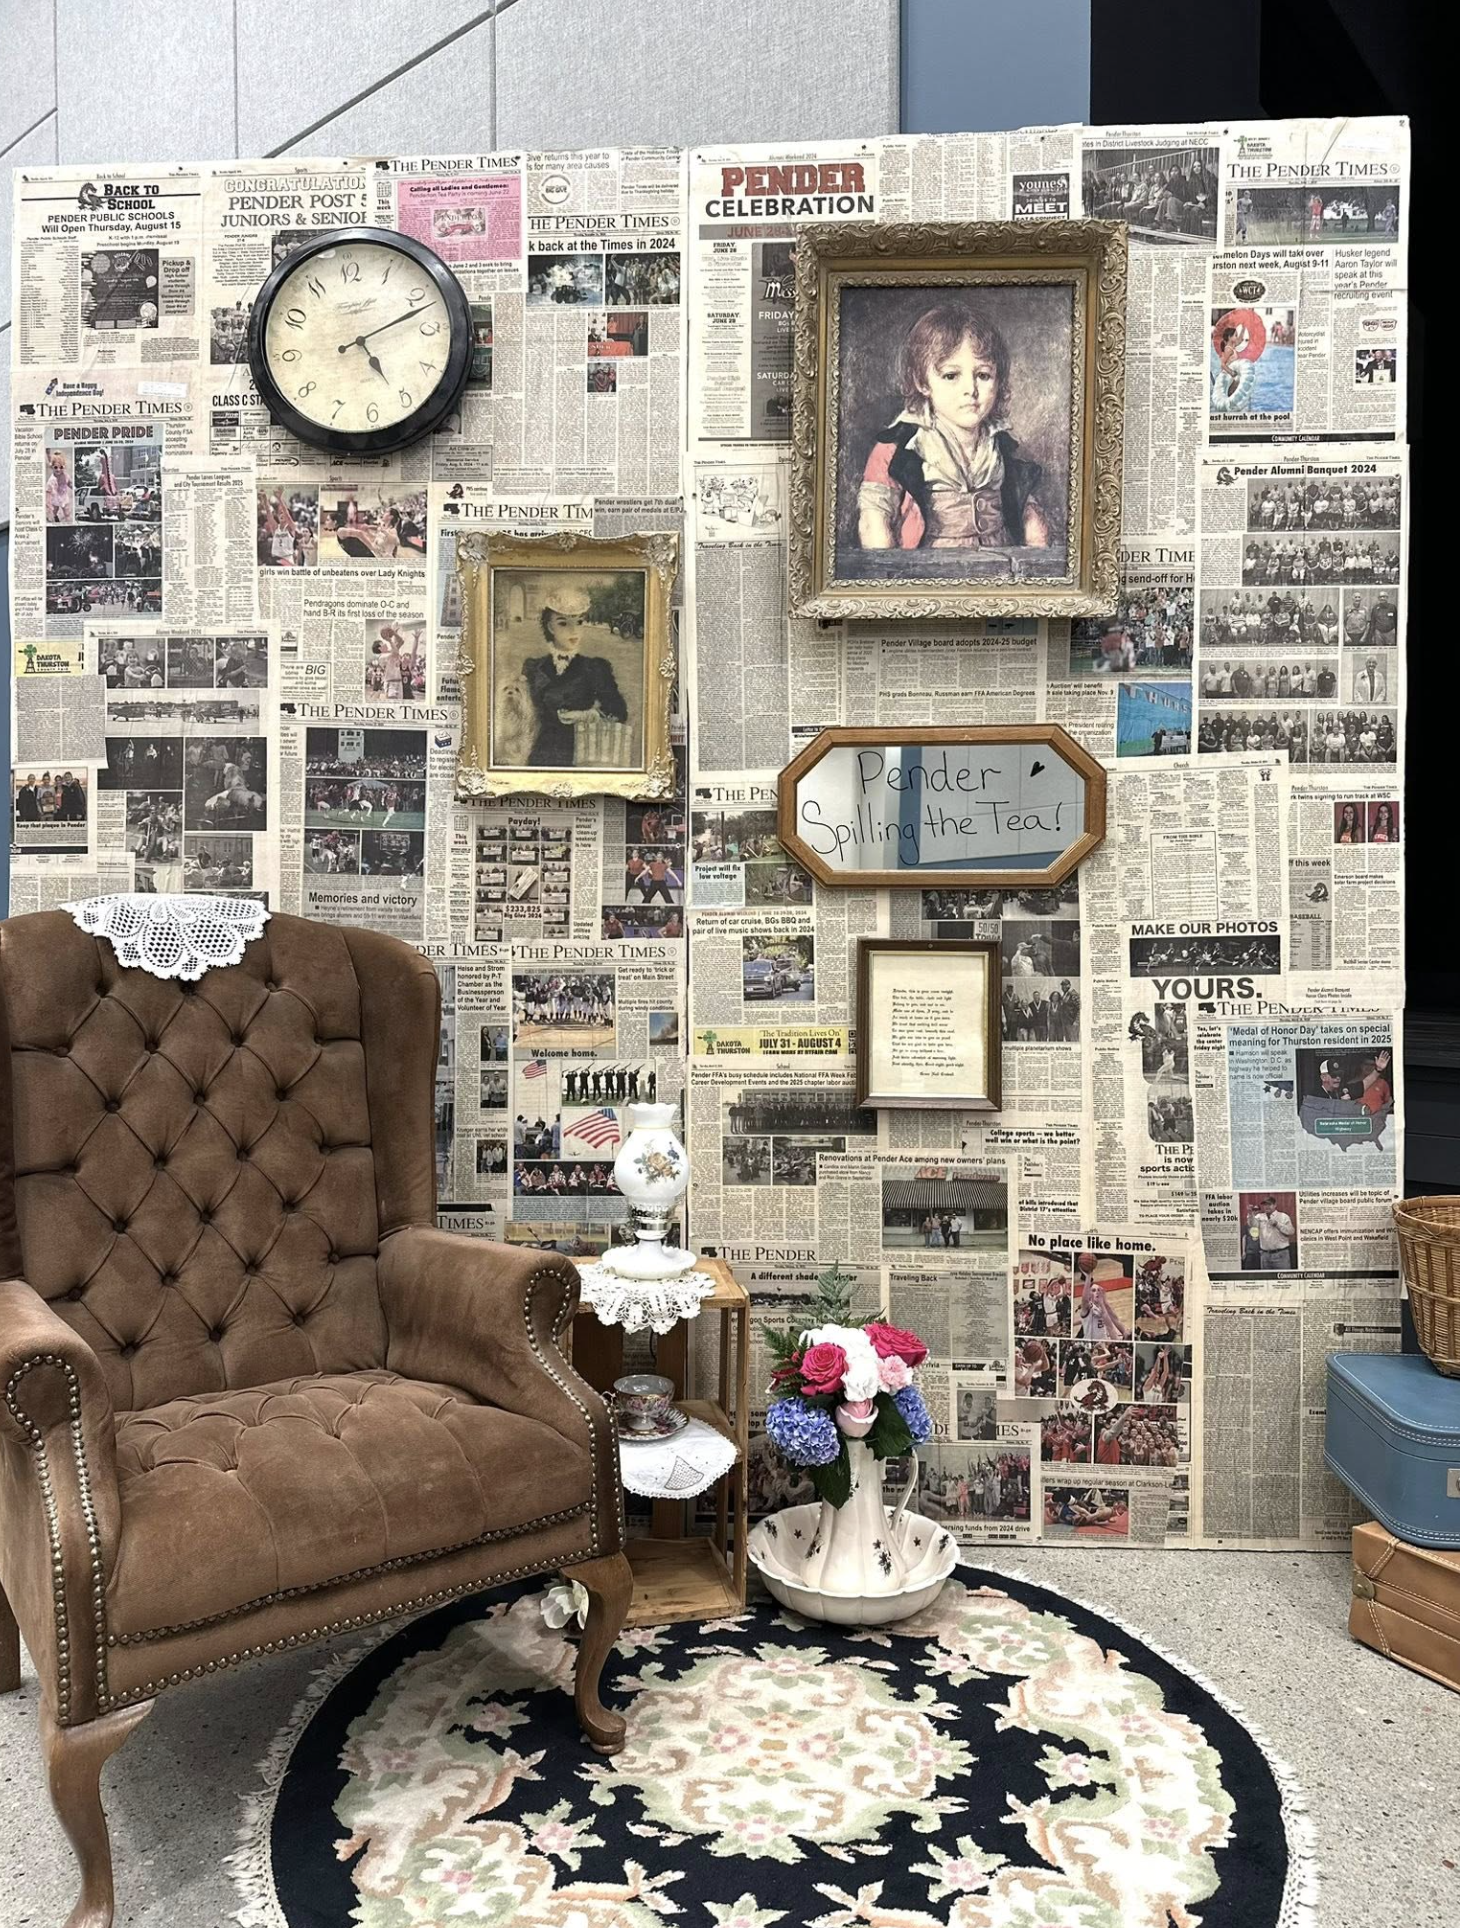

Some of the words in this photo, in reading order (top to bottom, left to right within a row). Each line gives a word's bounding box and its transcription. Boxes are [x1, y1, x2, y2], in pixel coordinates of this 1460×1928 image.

[390, 159, 418, 172] THE
[421, 157, 473, 172] PENDER
[476, 156, 518, 170] TIMES
[1226, 163, 1261, 178] THE
[1266, 161, 1330, 177] PENDER
[1335, 161, 1388, 176] TIMES
[720, 161, 866, 197] PENDER
[104, 184, 140, 197] BACK
[143, 184, 159, 196] TO
[107, 198, 156, 210] SCHOOL
[228, 194, 304, 211] PENDER
[309, 192, 356, 208] POST
[705, 194, 874, 218] CELEBRATION
[47, 213, 87, 223] PENDER
[89, 212, 125, 222] PUBLIC
[127, 210, 174, 221] SCHOOLS
[220, 212, 290, 227] JUNIORS
[295, 212, 306, 225] &
[556, 216, 616, 230] PENDER
[620, 214, 669, 228] TIMES
[41, 224, 58, 233] Will
[60, 223, 85, 234] Open
[87, 222, 132, 233] Thursday,
[134, 221, 167, 232] August
[170, 220, 181, 229] 15
[538, 239, 564, 252] back
[566, 240, 577, 251] at
[580, 239, 598, 251] the
[600, 238, 633, 250] Times
[636, 238, 646, 249] in
[649, 237, 675, 249] 2024
[1213, 250, 1248, 259] melon
[1250, 249, 1270, 259] Days
[1272, 249, 1287, 258] will
[340, 262, 362, 284] 12
[381, 266, 392, 285] 1
[307, 277, 326, 299] 11
[406, 287, 426, 307] 2
[284, 308, 307, 330] 10
[420, 320, 440, 336] 3
[282, 349, 302, 362] 9
[418, 360, 436, 376] 4
[298, 381, 316, 398] 8
[212, 394, 240, 407] CLASS
[241, 394, 248, 406] C
[398, 387, 412, 408] 5
[36, 402, 68, 416] THE
[71, 401, 131, 416] PENDER
[134, 399, 182, 414] TIMES
[331, 399, 346, 419] 7
[366, 402, 379, 423] 6
[1222, 412, 1248, 421] hurrah
[1273, 412, 1290, 421] pool
[53, 426, 109, 440] PENDER
[111, 425, 153, 439] PRIDE
[1234, 465, 1268, 475] Pender
[1270, 464, 1304, 475] Alumni
[1306, 464, 1347, 476] Banquet
[1350, 463, 1376, 473] 2024
[461, 503, 494, 518] THE
[498, 504, 558, 518] PENDER
[259, 567, 275, 577] girls
[290, 568, 311, 576] battle
[312, 567, 320, 576] of
[321, 568, 359, 576] unbeatens
[377, 568, 396, 579] Lady
[397, 568, 425, 579] Knights
[303, 598, 345, 610] Pendragons
[346, 599, 378, 608] dominate
[379, 599, 395, 608] O-C
[395, 600, 409, 609] and
[880, 638, 907, 647] Pender
[907, 638, 932, 648] Village
[933, 638, 954, 646] board
[955, 637, 980, 647] adopts
[981, 636, 1010, 646] 2024-25
[1011, 636, 1037, 647] budget
[298, 702, 330, 718] THE
[334, 704, 395, 719] PENDER
[400, 706, 448, 720] TIMES
[857, 750, 1002, 794] Pender
[713, 787, 746, 801] THE
[508, 816, 540, 827] Payday!
[802, 800, 920, 866] Spilling
[924, 804, 978, 838] the
[975, 801, 1062, 834] Tea!
[308, 891, 358, 907] Memories
[360, 893, 379, 904] and
[382, 893, 417, 907] victory
[504, 905, 541, 914] $233,825
[1131, 923, 1175, 936] MAKE
[1179, 922, 1211, 935] OUR
[1216, 920, 1278, 934] PHOTOS
[450, 944, 498, 956] TIMES
[514, 945, 548, 958] THE
[553, 944, 614, 958] PENDER
[617, 944, 666, 958] TIMES
[1151, 976, 1262, 1000] YOURS.
[1230, 1026, 1258, 1036] 'Medal
[1260, 1026, 1269, 1035] of
[1270, 1025, 1298, 1035] Honor
[1299, 1024, 1318, 1036] Day'
[1320, 1024, 1343, 1034] takes
[1359, 1023, 1390, 1035] special
[758, 1038, 778, 1049] JULY
[779, 1038, 790, 1048] 31
[797, 1037, 834, 1048] AUGUST
[834, 1037, 841, 1048] 4
[1229, 1037, 1266, 1049] meaning
[1267, 1036, 1280, 1046] for
[1281, 1035, 1321, 1046] Thurston
[1323, 1035, 1358, 1045] resident
[1360, 1034, 1369, 1044] in
[1370, 1034, 1392, 1044] 2025
[530, 1048, 569, 1057] Welcome
[571, 1048, 598, 1057] home.
[1155, 1144, 1180, 1155] THE
[818, 1153, 862, 1162] Renovations
[872, 1154, 898, 1163] Pender
[898, 1154, 913, 1163] Ace
[914, 1156, 939, 1165] among
[956, 1156, 985, 1164] owners'
[985, 1156, 1006, 1166] plans
[913, 1166, 948, 1180] ACE
[1028, 1234, 1046, 1247] No
[1049, 1234, 1083, 1250] place
[1087, 1235, 1111, 1250] like
[1115, 1236, 1156, 1252] home.
[719, 1246, 751, 1261] THE
[755, 1246, 816, 1262] PENDER
[758, 1271, 793, 1280] different
[889, 1273, 923, 1282] Traveling
[924, 1273, 937, 1282] Back
